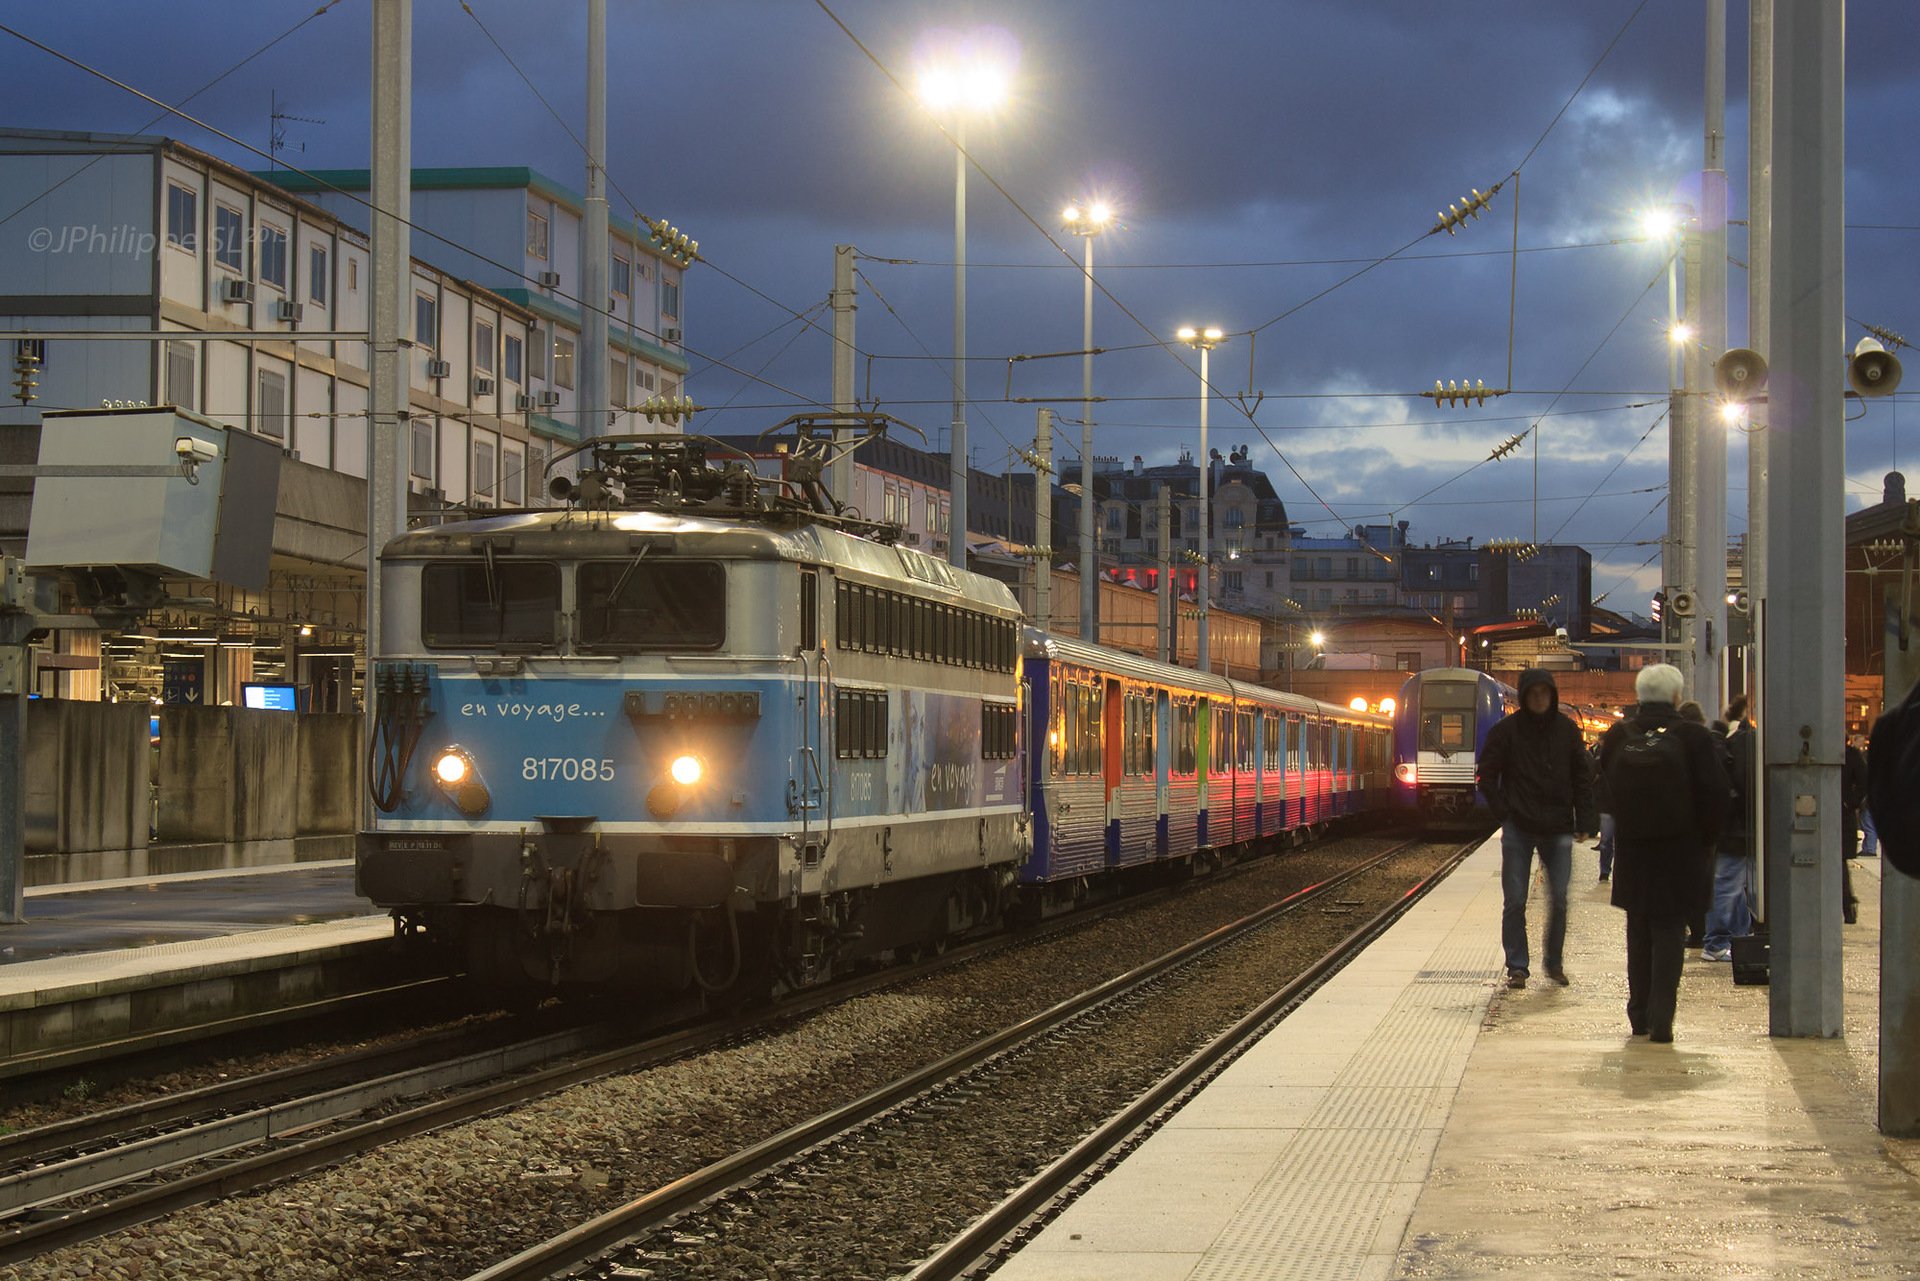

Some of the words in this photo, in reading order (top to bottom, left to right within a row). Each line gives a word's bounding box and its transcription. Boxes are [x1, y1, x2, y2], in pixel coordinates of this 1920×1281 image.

[461, 702, 487, 717] en
[497, 702, 605, 723] voyage...
[522, 757, 615, 782] 817085
[931, 763, 942, 792] en
